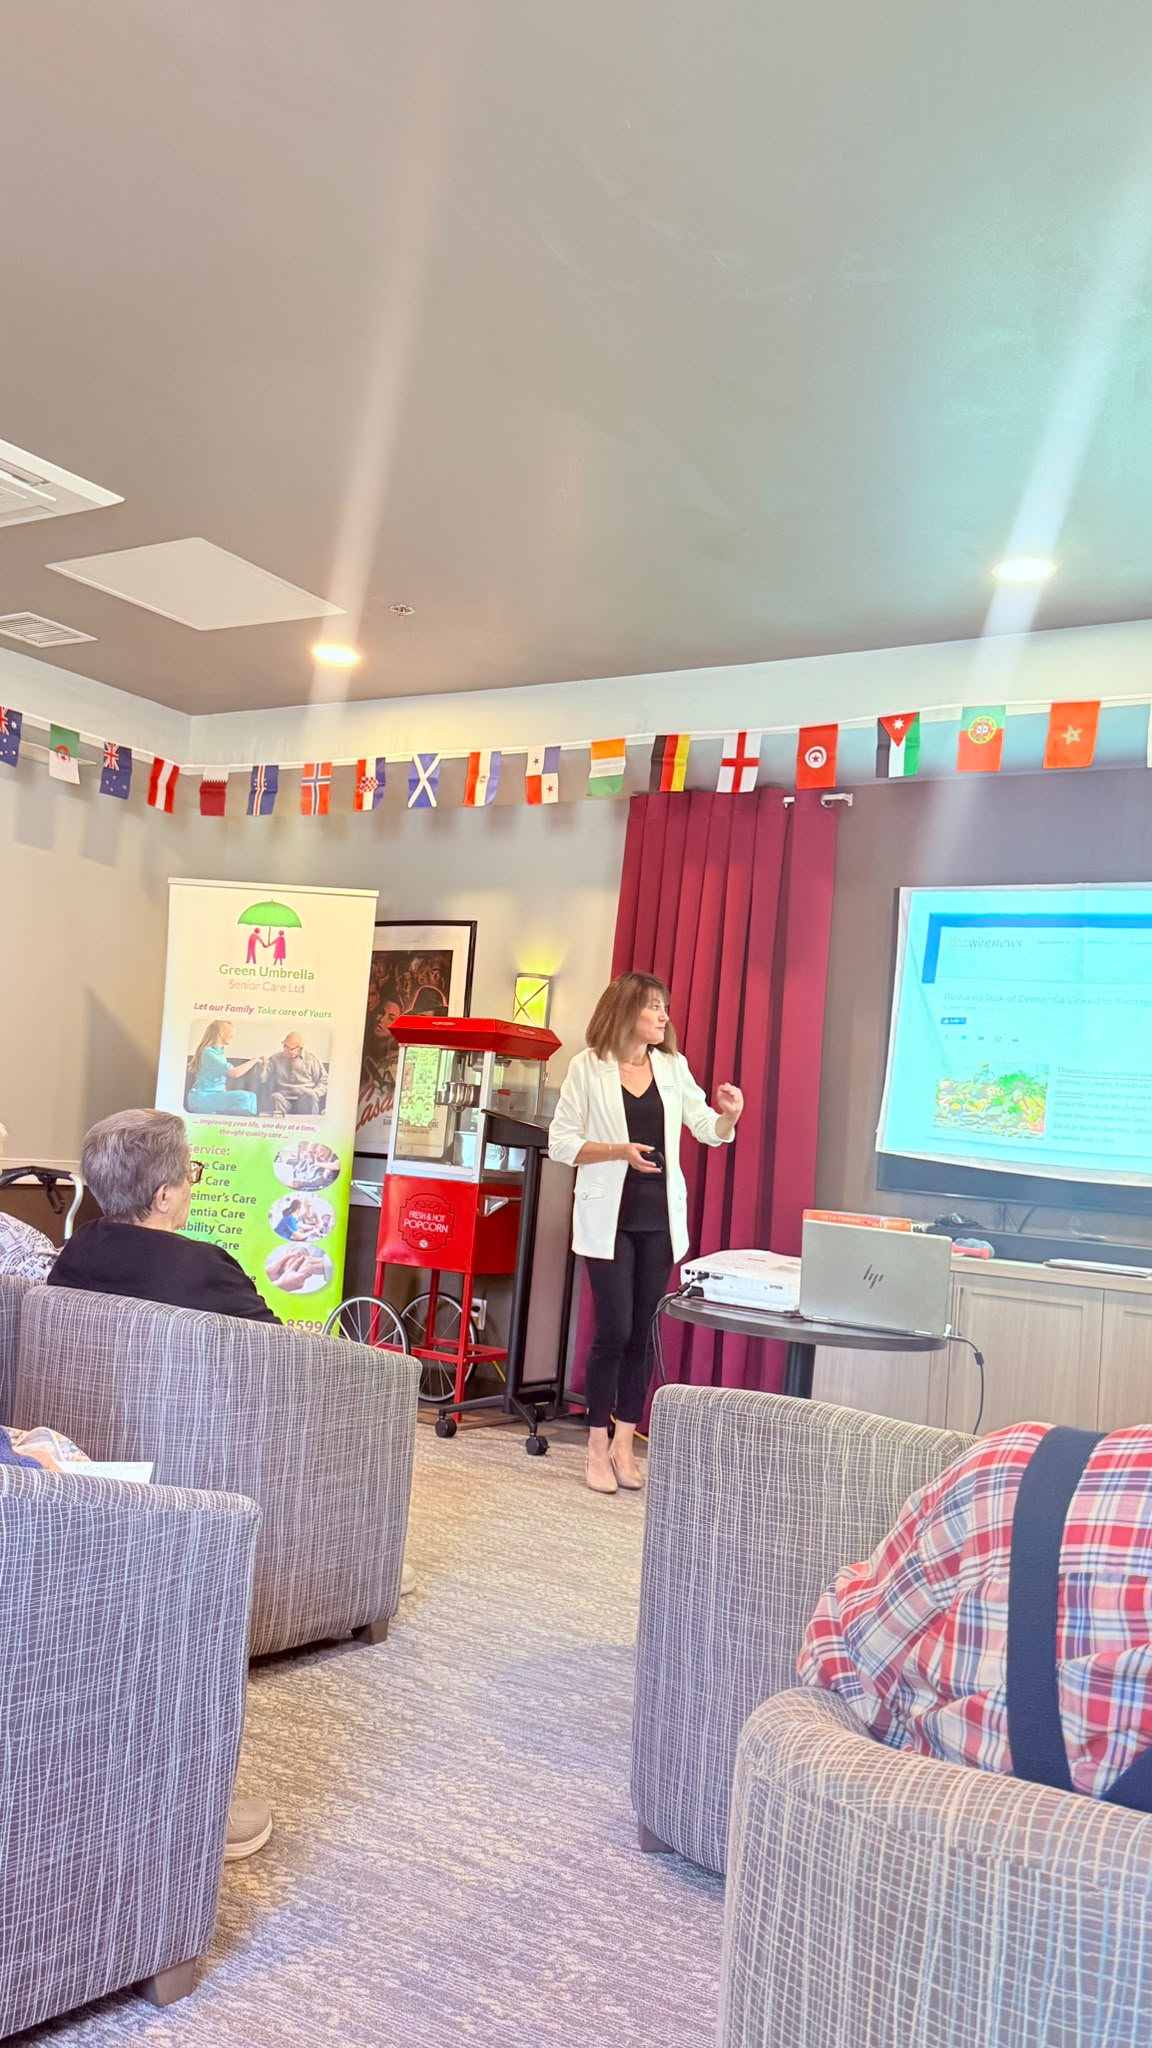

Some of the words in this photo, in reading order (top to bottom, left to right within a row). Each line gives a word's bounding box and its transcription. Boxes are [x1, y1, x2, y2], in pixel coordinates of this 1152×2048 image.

[219, 963, 256, 976] Green
[259, 966, 315, 981] Umbrella
[228, 979, 260, 990] Senior
[262, 981, 287, 992] Care
[288, 984, 305, 993] Ltd
[194, 1002, 208, 1011] Let
[209, 1004, 224, 1012] our
[225, 1004, 254, 1015] Family
[257, 1006, 277, 1015] Take
[278, 1008, 297, 1016] care
[298, 1009, 309, 1017] of
[309, 1009, 332, 1018] Yours
[212, 1161, 237, 1172] Care
[205, 1176, 230, 1187] Care
[191, 1191, 229, 1202] eimer's
[232, 1193, 257, 1205] Care
[190, 1207, 218, 1218] entia
[220, 1208, 246, 1219] Care
[408, 1210, 427, 1220] FRESH
[432, 1213, 446, 1223] HOT
[217, 1223, 243, 1234] Care
[403, 1217, 449, 1233] POPCORN
[215, 1239, 240, 1250] Care
[863, 1264, 884, 1290] hp
